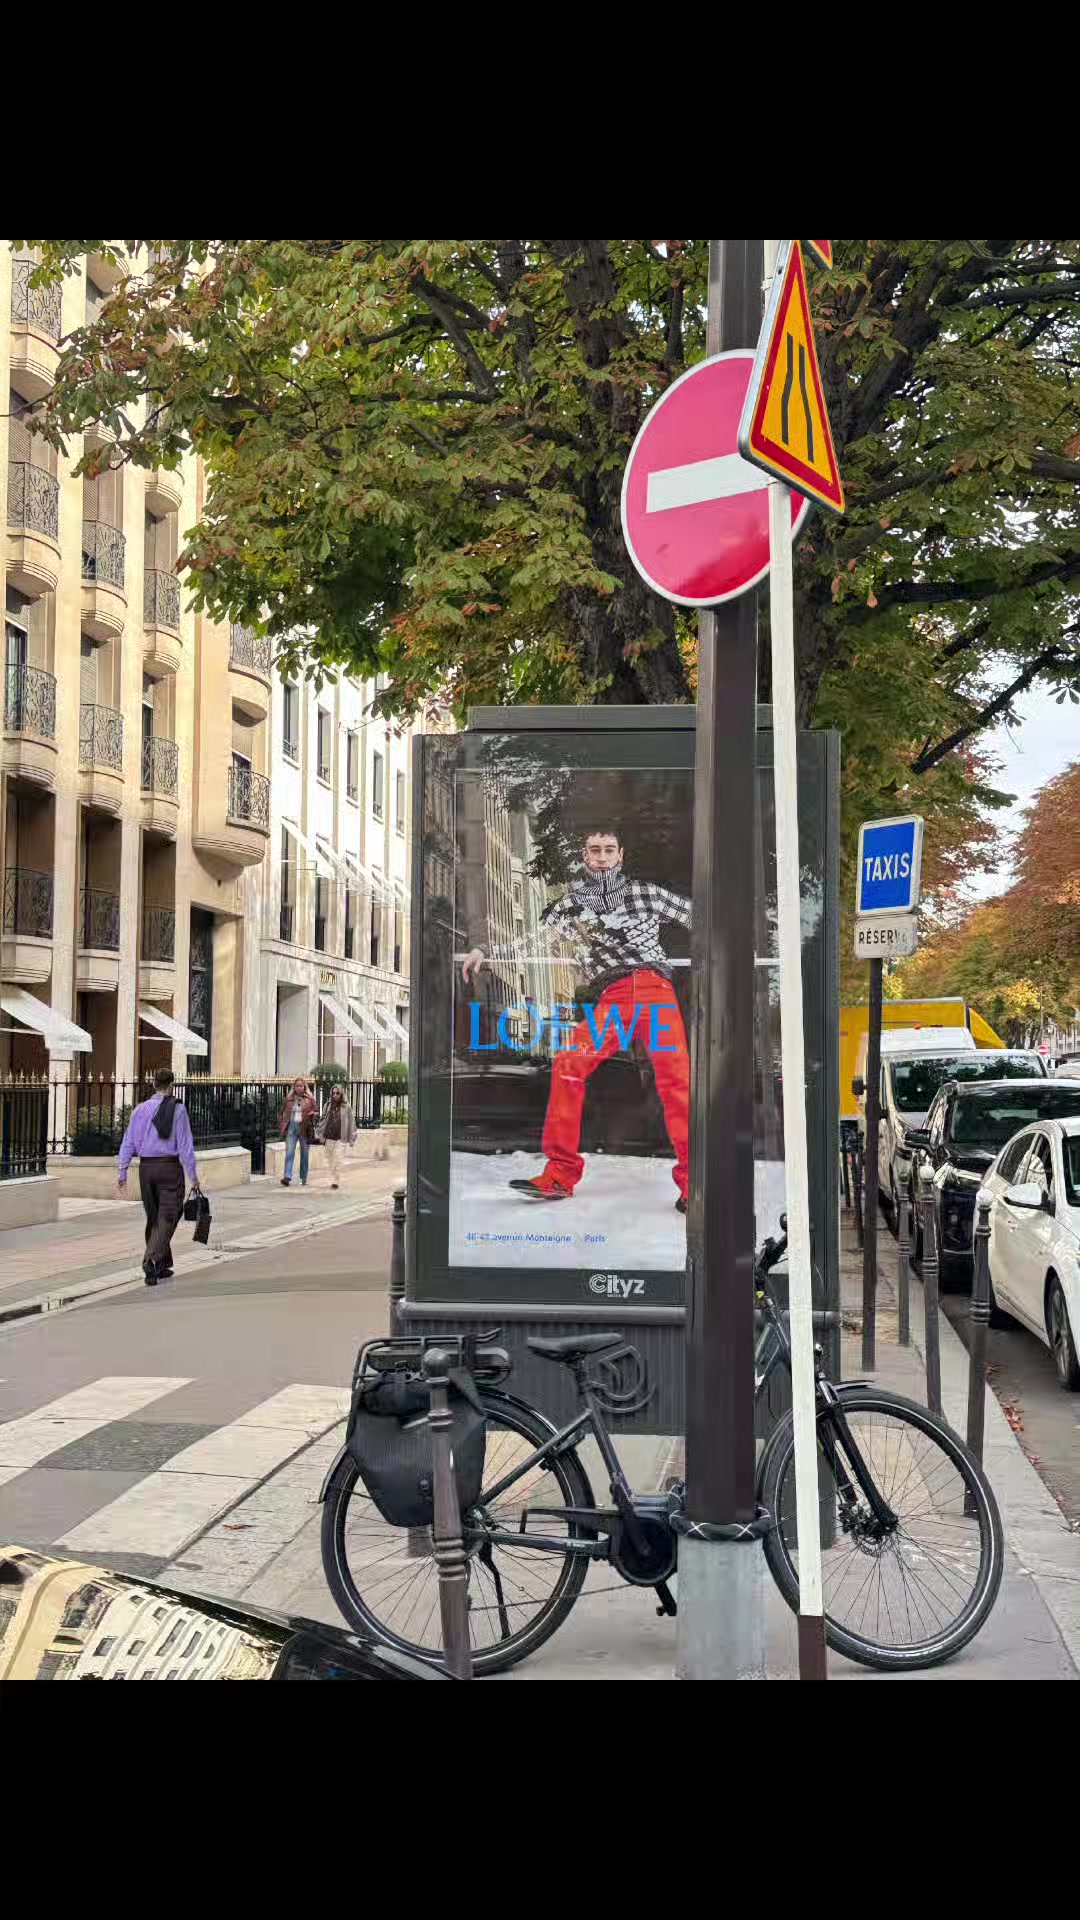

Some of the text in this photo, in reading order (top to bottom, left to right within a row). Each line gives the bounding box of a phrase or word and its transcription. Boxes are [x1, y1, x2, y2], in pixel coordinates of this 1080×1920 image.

[864, 852, 910, 881] TAXIS
[858, 928, 908, 944] RÉSERV
[467, 1001, 677, 1052] LOEWE
[584, 1234, 606, 1243] Paris
[589, 1274, 645, 1298] Cityz
